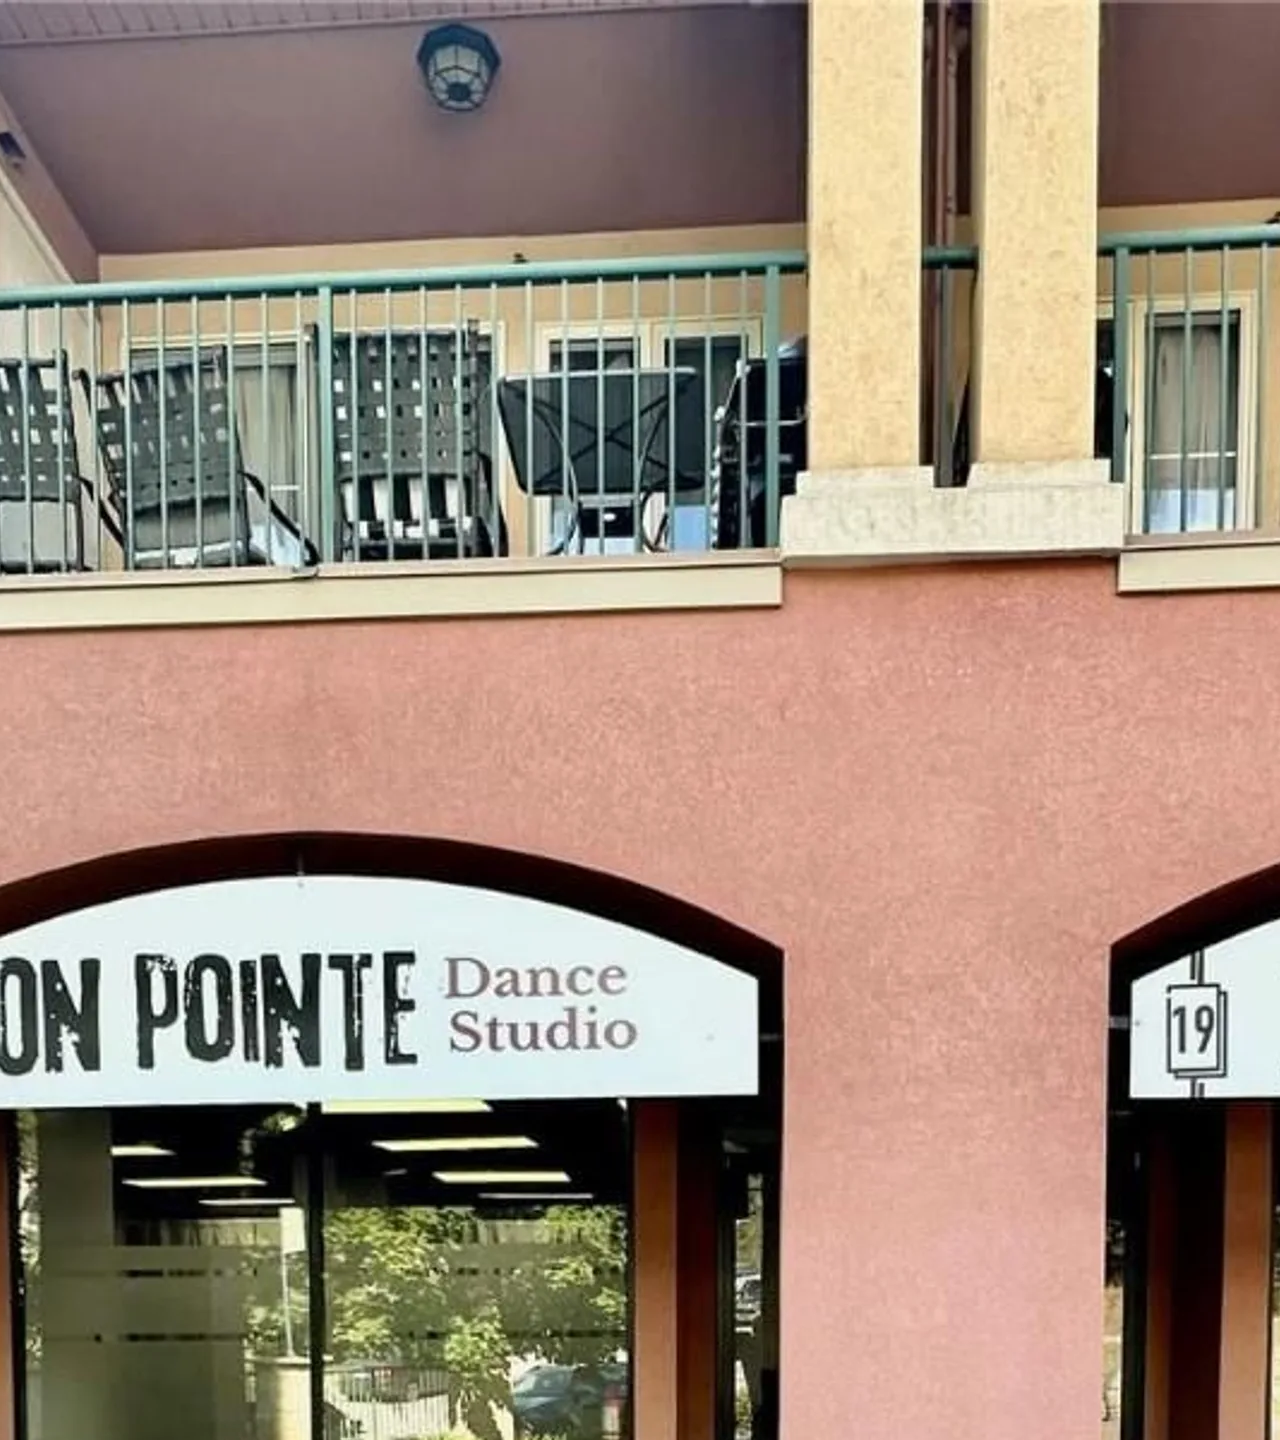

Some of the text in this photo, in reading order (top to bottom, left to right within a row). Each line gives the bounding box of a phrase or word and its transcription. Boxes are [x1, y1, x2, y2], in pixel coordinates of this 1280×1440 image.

[444, 956, 627, 1000] Dance
[135, 952, 418, 1070] POINTE
[449, 1008, 637, 1052] Studio
[1173, 1005, 1215, 1054] 19
